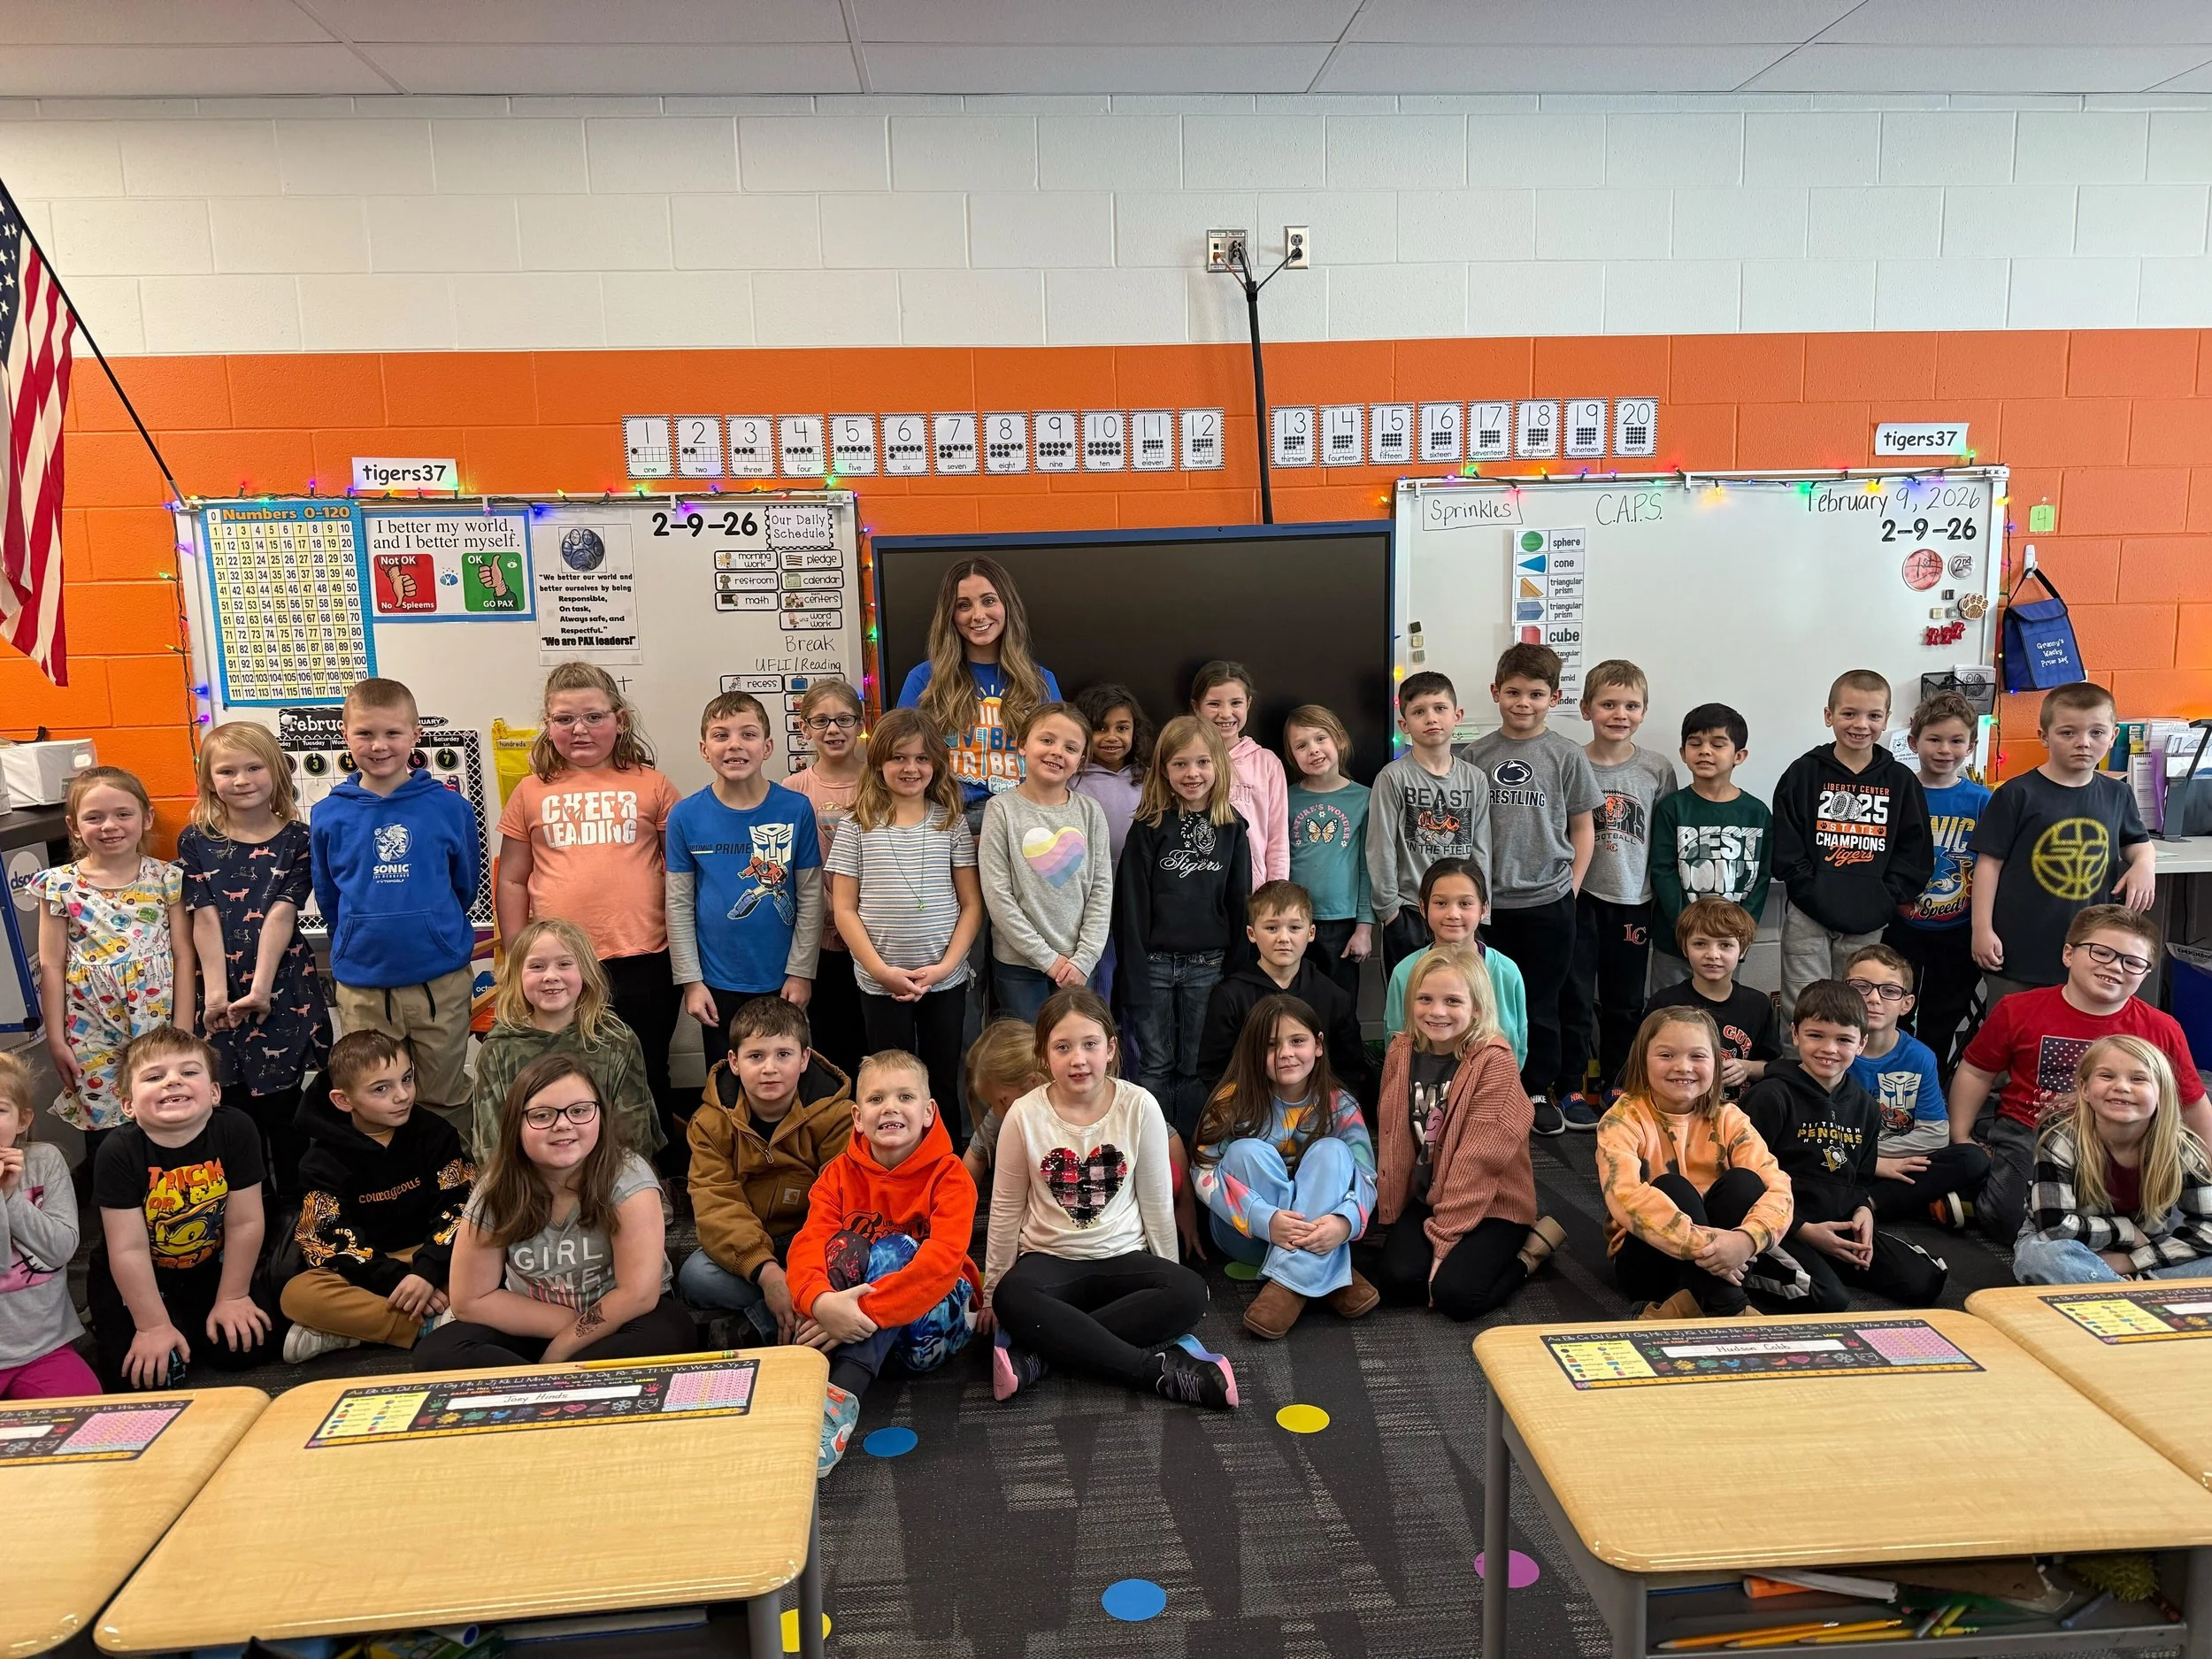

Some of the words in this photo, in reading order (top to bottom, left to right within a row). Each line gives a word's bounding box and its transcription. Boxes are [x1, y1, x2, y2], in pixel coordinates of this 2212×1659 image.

[1284, 412, 1306, 434] 13
[1333, 411, 1354, 433] 14
[1382, 410, 1403, 431] 15
[1431, 408, 1453, 429] 16
[1479, 406, 1502, 427] 17
[1528, 405, 1550, 426] 18
[1577, 404, 1598, 426] 19
[1623, 403, 1650, 425] 20
[692, 422, 706, 443] 2
[744, 422, 757, 443] 3
[795, 421, 807, 442] 4
[846, 420, 859, 442] 5
[898, 419, 911, 442] 6
[949, 419, 960, 441] 7
[1000, 419, 1012, 440] 8
[1048, 417, 1062, 438] 9
[1094, 416, 1117, 438] 10
[1144, 416, 1161, 437] 11
[1192, 415, 1213, 436] 12
[1884, 431, 1957, 450] tigers37
[1523, 447, 1550, 457] eighteen
[363, 465, 447, 486] tigers37
[999, 461, 1016, 472] eight
[1430, 499, 1511, 526] Sprinkles
[1809, 487, 1887, 517] February
[1926, 487, 1980, 510] 2026
[223, 508, 297, 520] Numbers
[304, 506, 350, 518] 0-120
[797, 515, 825, 526] Daily
[2038, 508, 2047, 526] 4
[377, 520, 382, 533] I
[388, 520, 430, 533] better
[436, 522, 459, 535] my
[465, 519, 514, 534] world,
[774, 529, 825, 538] Schedule
[374, 536, 400, 549] and
[405, 535, 411, 548] I
[417, 534, 458, 548] better
[465, 534, 519, 550] myself.
[1553, 538, 1580, 549] sphere
[380, 557, 399, 565] Not
[402, 556, 416, 565] OK
[739, 552, 771, 561] morning
[807, 555, 836, 565] pledge
[1955, 557, 1972, 572] 2nd
[1550, 579, 1583, 588] triangular
[746, 595, 769, 604] math
[804, 595, 838, 603] centers
[1550, 603, 1582, 611] triangular
[786, 635, 834, 652] Break
[1549, 628, 1579, 641] cube
[312, 759, 319, 769] 3
[413, 756, 420, 764] 6
[444, 755, 450, 764] 7
[1405, 787, 1471, 808] BEAST
[1489, 789, 1545, 807] RESTLING
[1860, 786, 1889, 795] CENTER
[541, 791, 637, 824] CHEER
[1293, 803, 1324, 839] NATURE'S
[1327, 805, 1351, 840] WONDER
[1831, 824, 1874, 836] STATE
[542, 819, 636, 848] LEADING
[1678, 826, 1763, 860] BEST
[1816, 833, 1886, 851] CHAMPIONS
[715, 843, 751, 854] PRIME
[1419, 845, 1440, 854] THE
[1443, 845, 1471, 855] FIELD
[1824, 845, 1874, 867] Tigers
[373, 864, 409, 874] SONIC
[1160, 849, 1223, 878] Tigers
[1624, 924, 1647, 945] LC
[149, 1157, 225, 1192] TRICK
[359, 1178, 420, 1203] courageous
[149, 1197, 175, 1210] OR
[514, 1237, 603, 1270] GIRL
